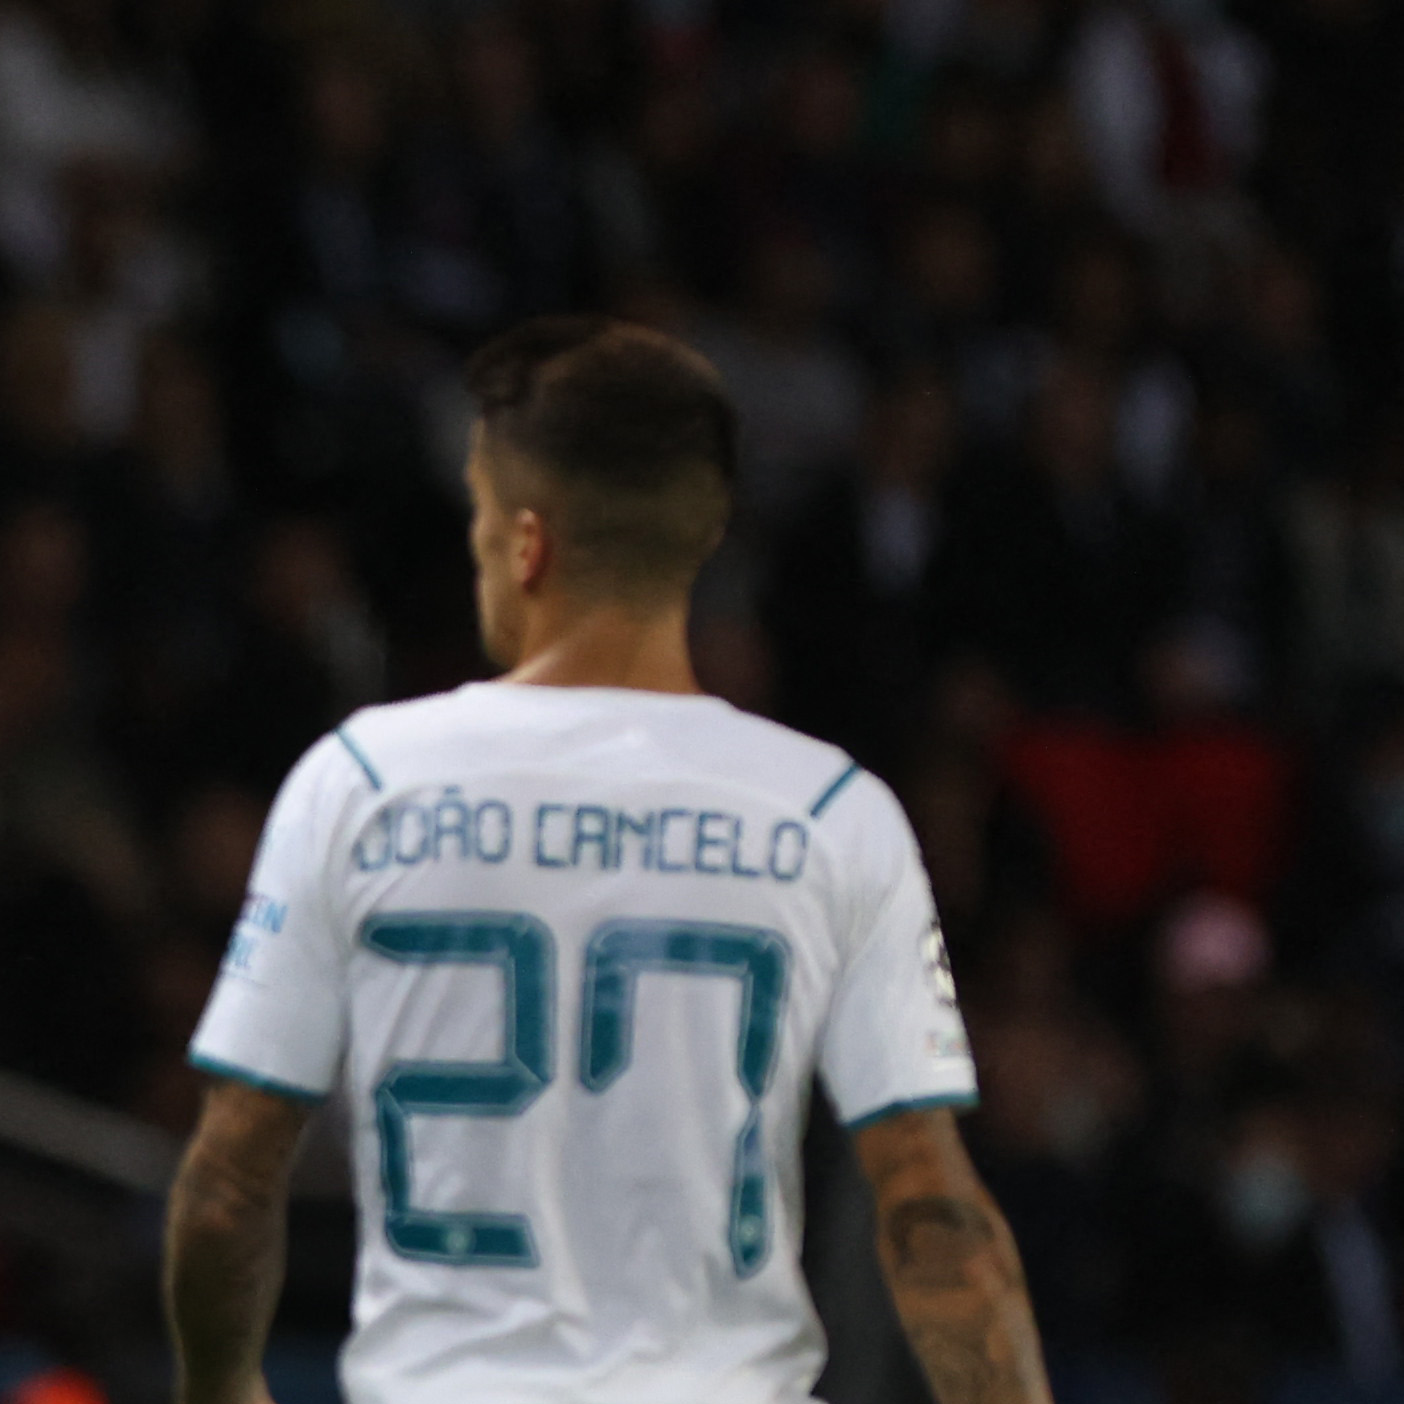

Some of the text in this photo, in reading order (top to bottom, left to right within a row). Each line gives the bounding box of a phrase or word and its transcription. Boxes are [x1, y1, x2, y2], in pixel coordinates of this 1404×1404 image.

[352, 784, 809, 883] JOÃO CANCELO
[355, 909, 791, 1280] 27
